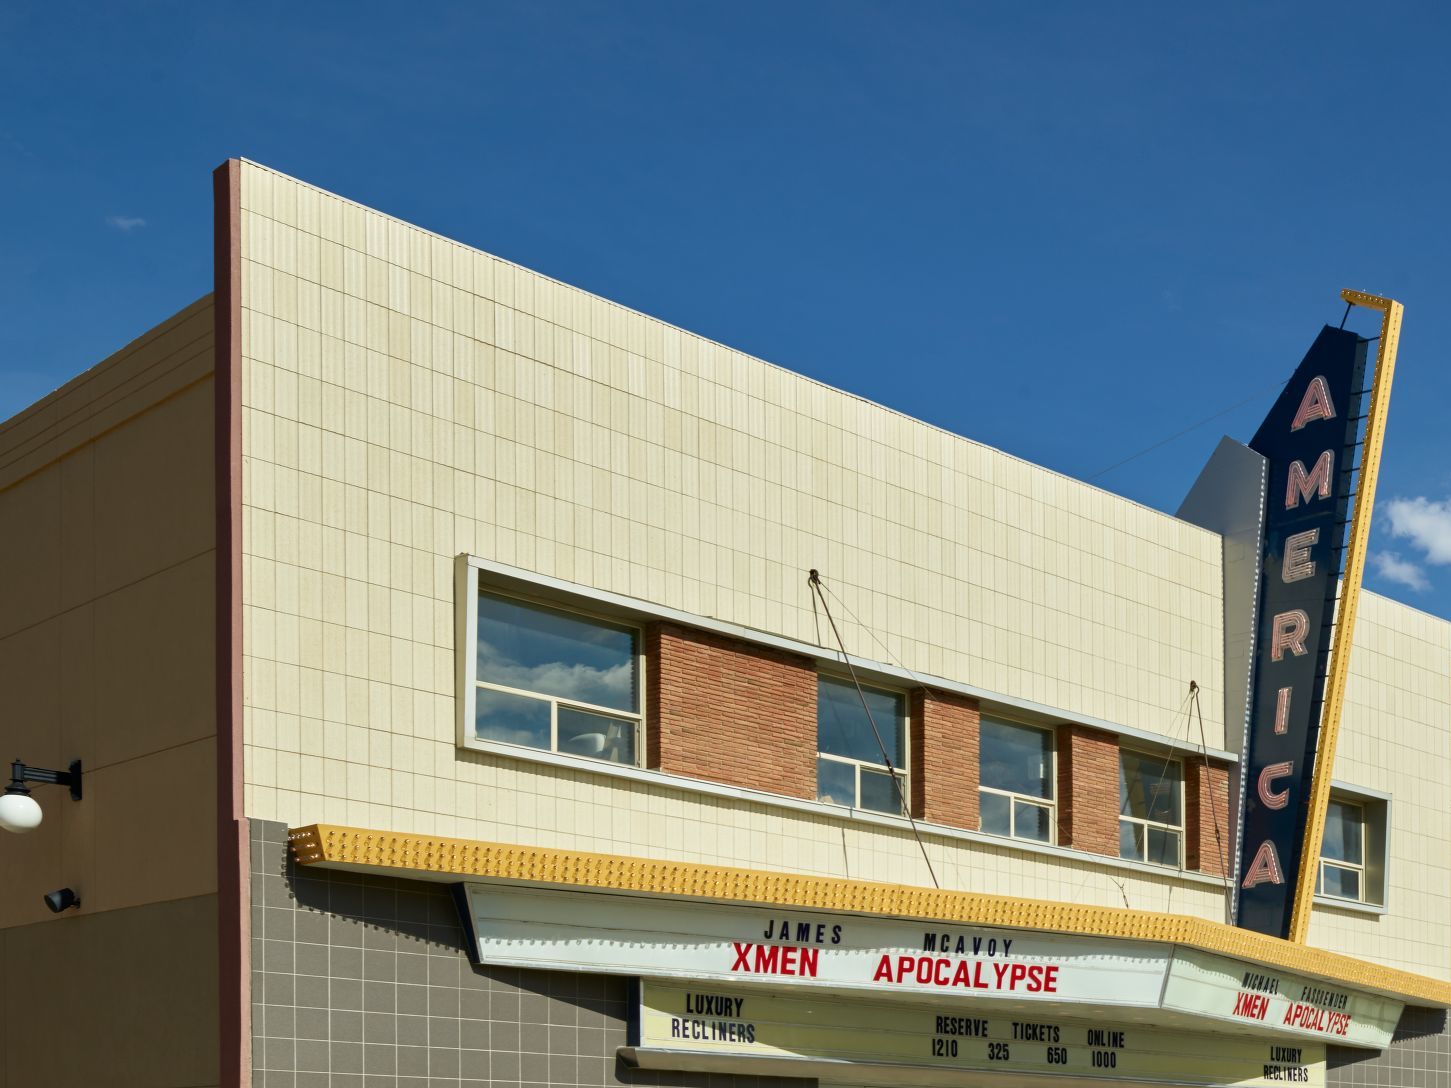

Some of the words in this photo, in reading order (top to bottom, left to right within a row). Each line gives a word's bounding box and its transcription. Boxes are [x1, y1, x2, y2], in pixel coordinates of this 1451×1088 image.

[1241, 374, 1335, 889] AMERICA
[764, 919, 842, 945] JAMES
[923, 932, 1012, 958] MCAVOY
[731, 941, 818, 977] XMEN
[873, 954, 1059, 992] APOCALYPSE
[1241, 971, 1280, 996] MICHAEL
[686, 993, 744, 1018] LUXURY
[1232, 991, 1270, 1021] XMEN
[1283, 1002, 1352, 1036] APOCALYPSE
[671, 1018, 755, 1044] RECLINERS
[936, 1015, 988, 1038] RESERVE
[1012, 1022, 1060, 1043] TICKETS
[1087, 1028, 1125, 1048] ONLINE
[932, 1038, 958, 1058] 1210
[988, 1042, 1010, 1061] 325
[1047, 1046, 1068, 1065] 650
[1092, 1051, 1117, 1069] 1000
[1270, 1046, 1303, 1063] LUXURY
[1263, 1064, 1309, 1083] RECLINERS
